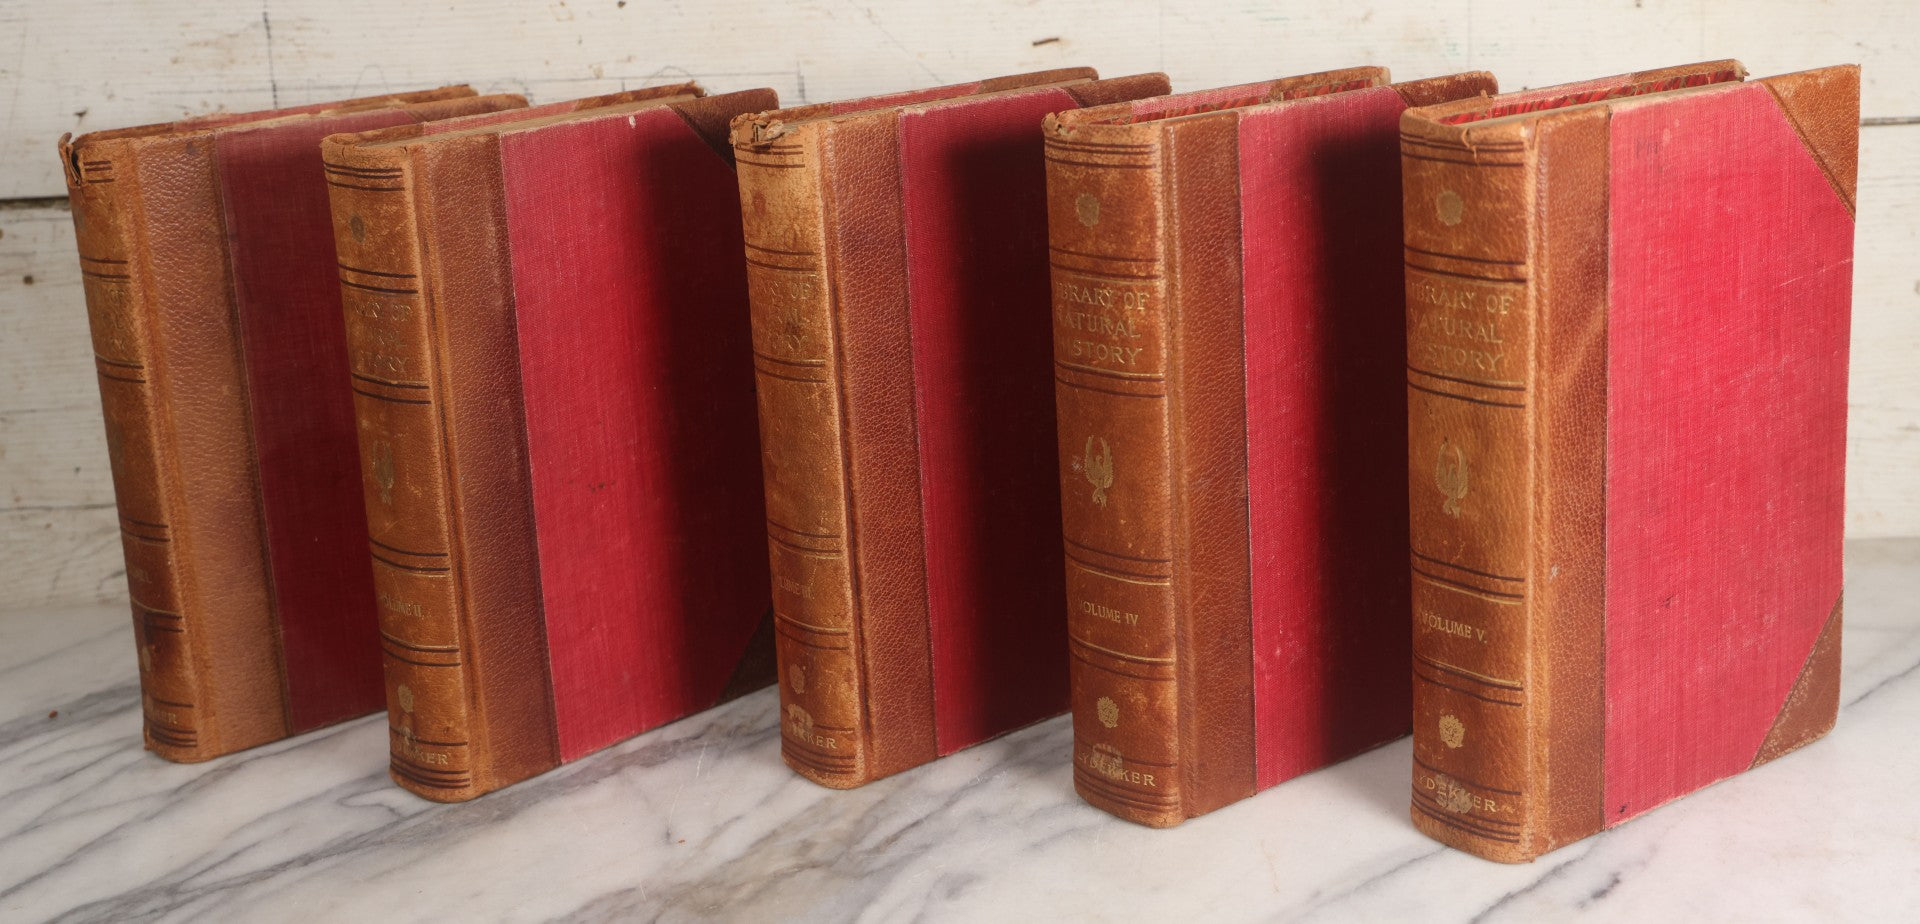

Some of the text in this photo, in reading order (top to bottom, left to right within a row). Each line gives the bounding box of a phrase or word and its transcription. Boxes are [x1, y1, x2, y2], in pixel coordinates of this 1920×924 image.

[1123, 291, 1150, 311] OF
[1486, 294, 1515, 316] OF
[1420, 611, 1472, 639] VOLUME
